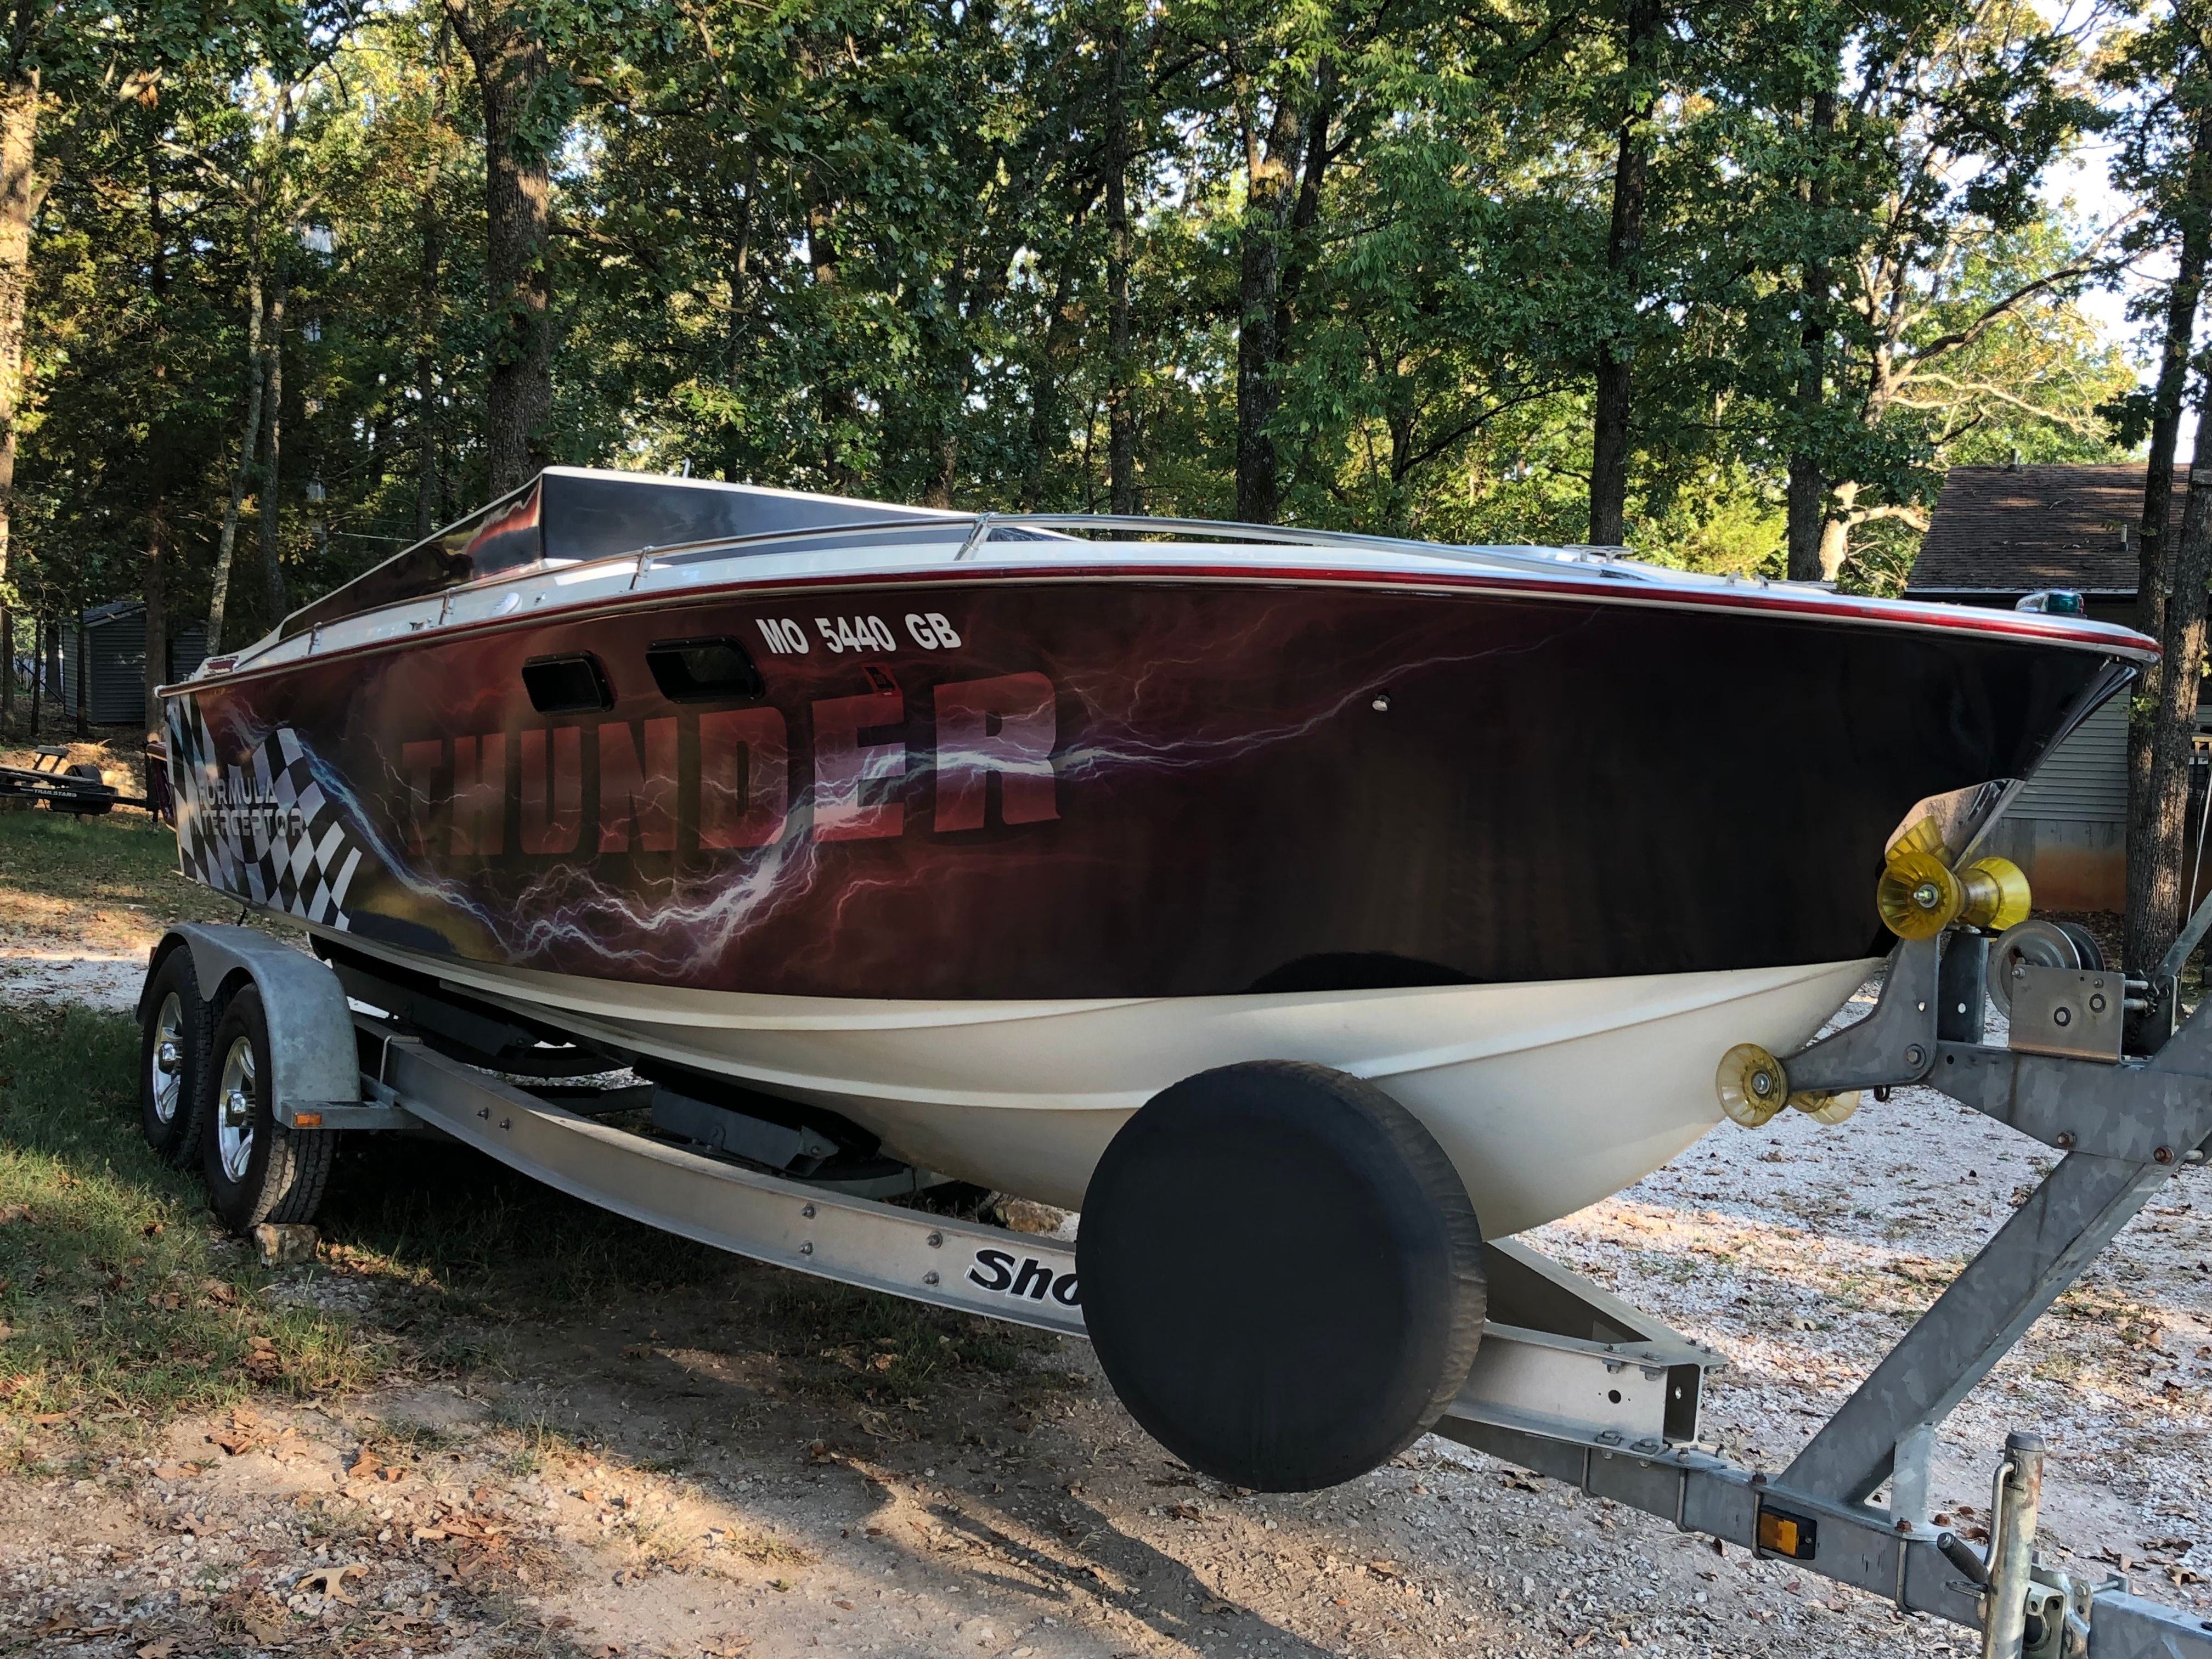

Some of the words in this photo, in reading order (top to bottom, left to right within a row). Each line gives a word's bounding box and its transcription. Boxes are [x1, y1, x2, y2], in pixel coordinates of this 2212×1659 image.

[755, 618, 809, 654] MO
[814, 616, 896, 653] 5440
[905, 613, 962, 650] GB
[402, 671, 1061, 856] THUNDER
[198, 776, 278, 805] FORMULA
[191, 809, 304, 837] INTERCEPTOR
